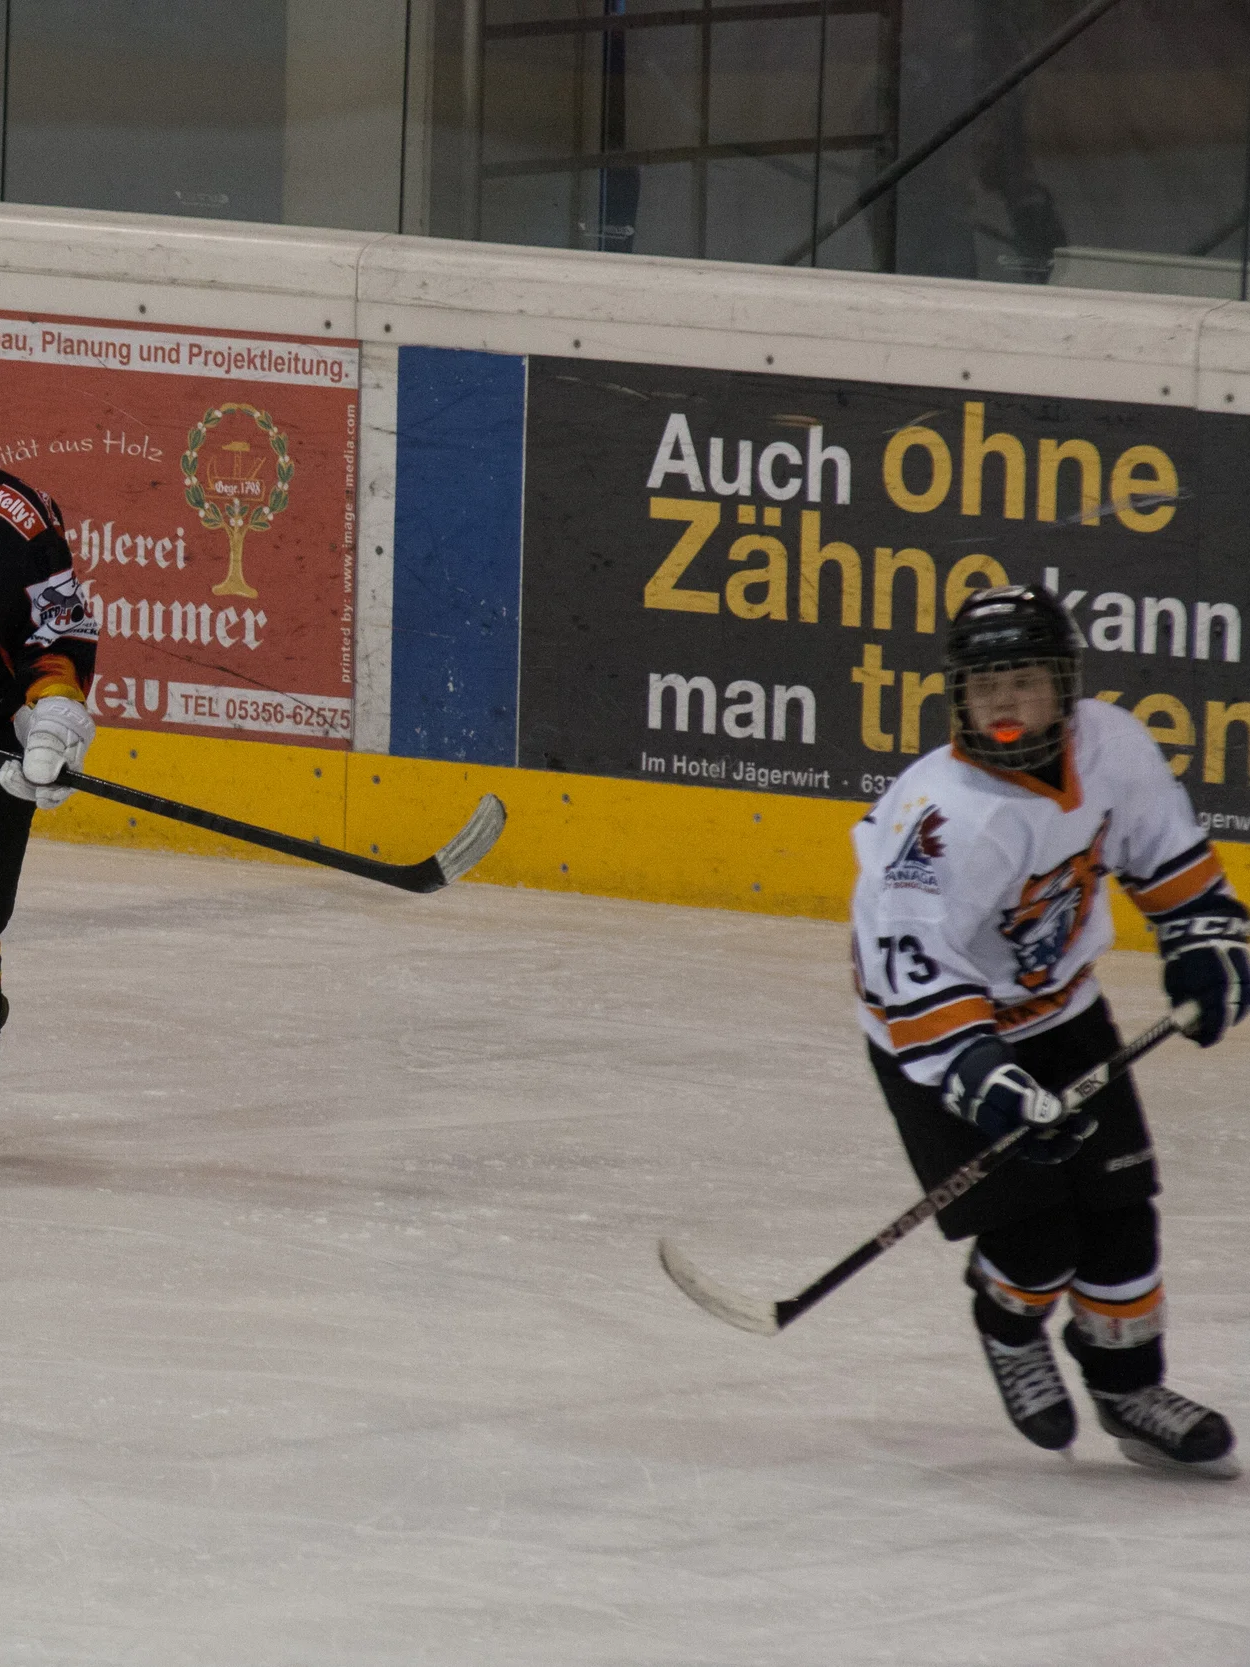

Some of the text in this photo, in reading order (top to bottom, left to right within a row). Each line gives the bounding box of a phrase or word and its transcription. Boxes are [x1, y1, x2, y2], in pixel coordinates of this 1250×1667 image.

[41, 330, 131, 366] Planung
[138, 342, 180, 365] und
[188, 347, 350, 384] Projektleitung.
[49, 438, 93, 454] aus
[103, 430, 163, 463] Holz
[646, 401, 1179, 533] Auch ohne
[644, 497, 1241, 663] Zähne kann
[341, 628, 352, 684] printed
[180, 694, 220, 718] TEL
[226, 698, 351, 730] 05356-62575
[646, 643, 1250, 785] man tren
[640, 751, 666, 773] Im
[673, 754, 726, 779] Hotel
[732, 760, 831, 789] Jägerwirt
[877, 934, 940, 994] 73
